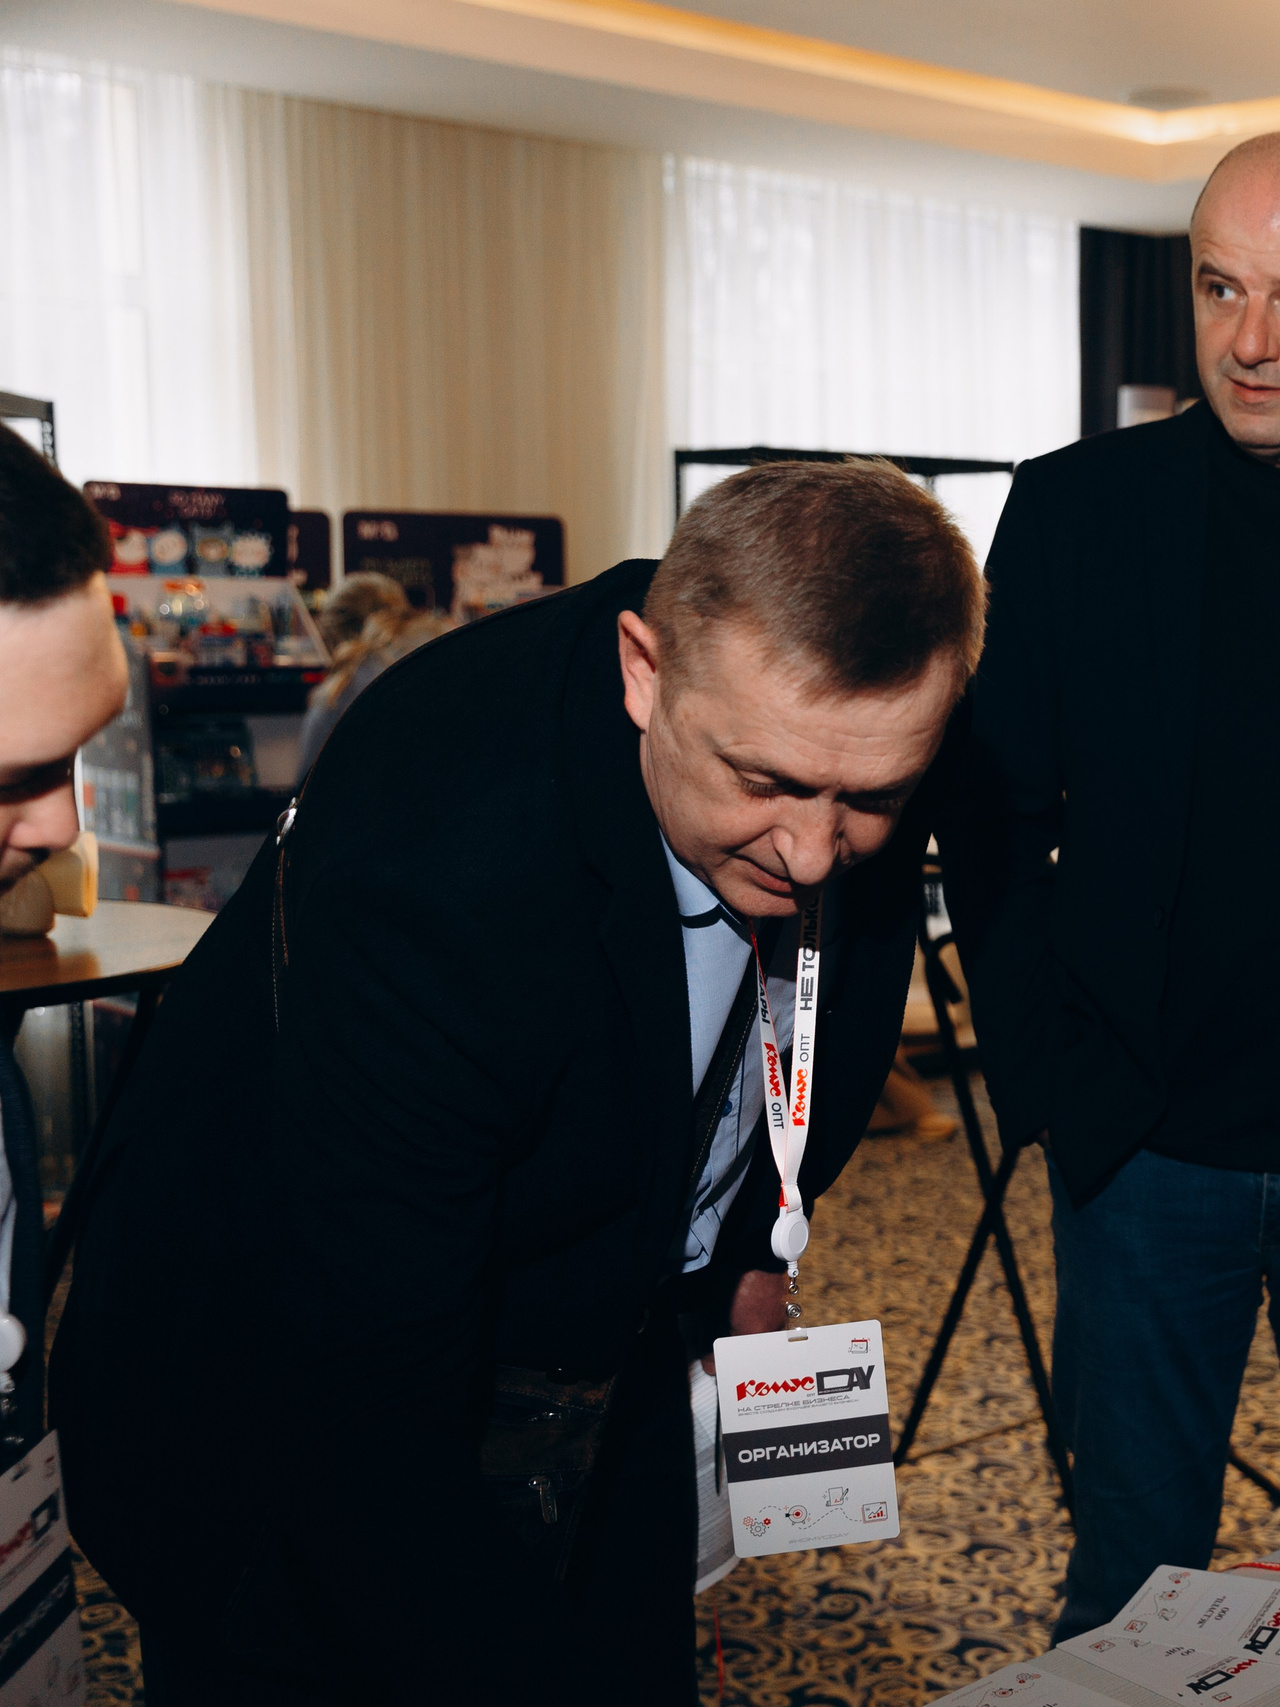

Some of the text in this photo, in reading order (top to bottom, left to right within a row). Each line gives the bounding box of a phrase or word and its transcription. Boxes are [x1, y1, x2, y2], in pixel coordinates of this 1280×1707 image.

[799, 976, 814, 1011] НЕ
[799, 1033, 811, 1063] ОПТ
[764, 1042, 782, 1097] Комус
[791, 1068, 808, 1127] Комус
[771, 1102, 785, 1130] ОПТ
[736, 1365, 875, 1401] Комус DAY
[754, 1400, 800, 1411] СТРЕЛКЕ
[802, 1395, 850, 1406] БИЗНЕСА
[738, 1433, 881, 1463] ОРГАНИЗАТОР
